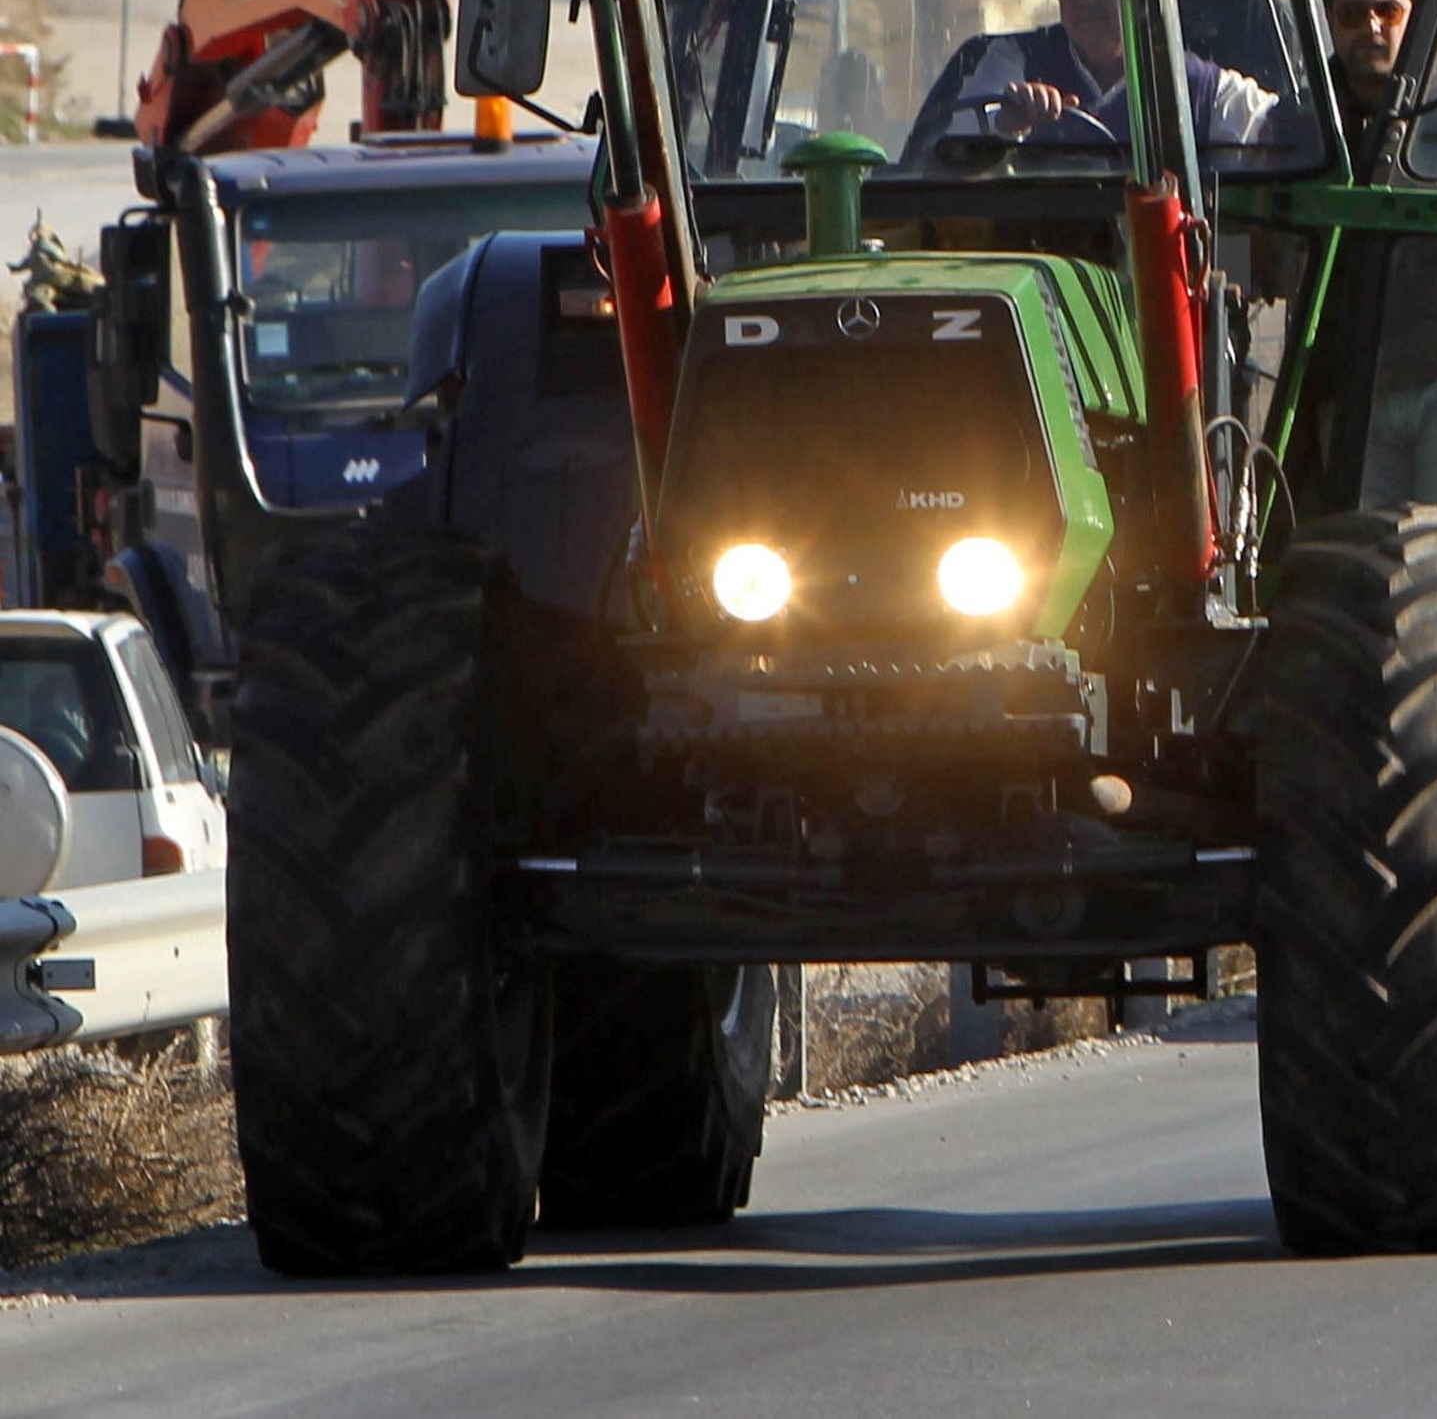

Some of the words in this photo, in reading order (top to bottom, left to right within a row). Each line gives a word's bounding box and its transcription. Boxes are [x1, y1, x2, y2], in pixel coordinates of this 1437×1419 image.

[725, 316, 779, 346] D
[932, 310, 982, 340] Z
[910, 491, 965, 509] KHD
